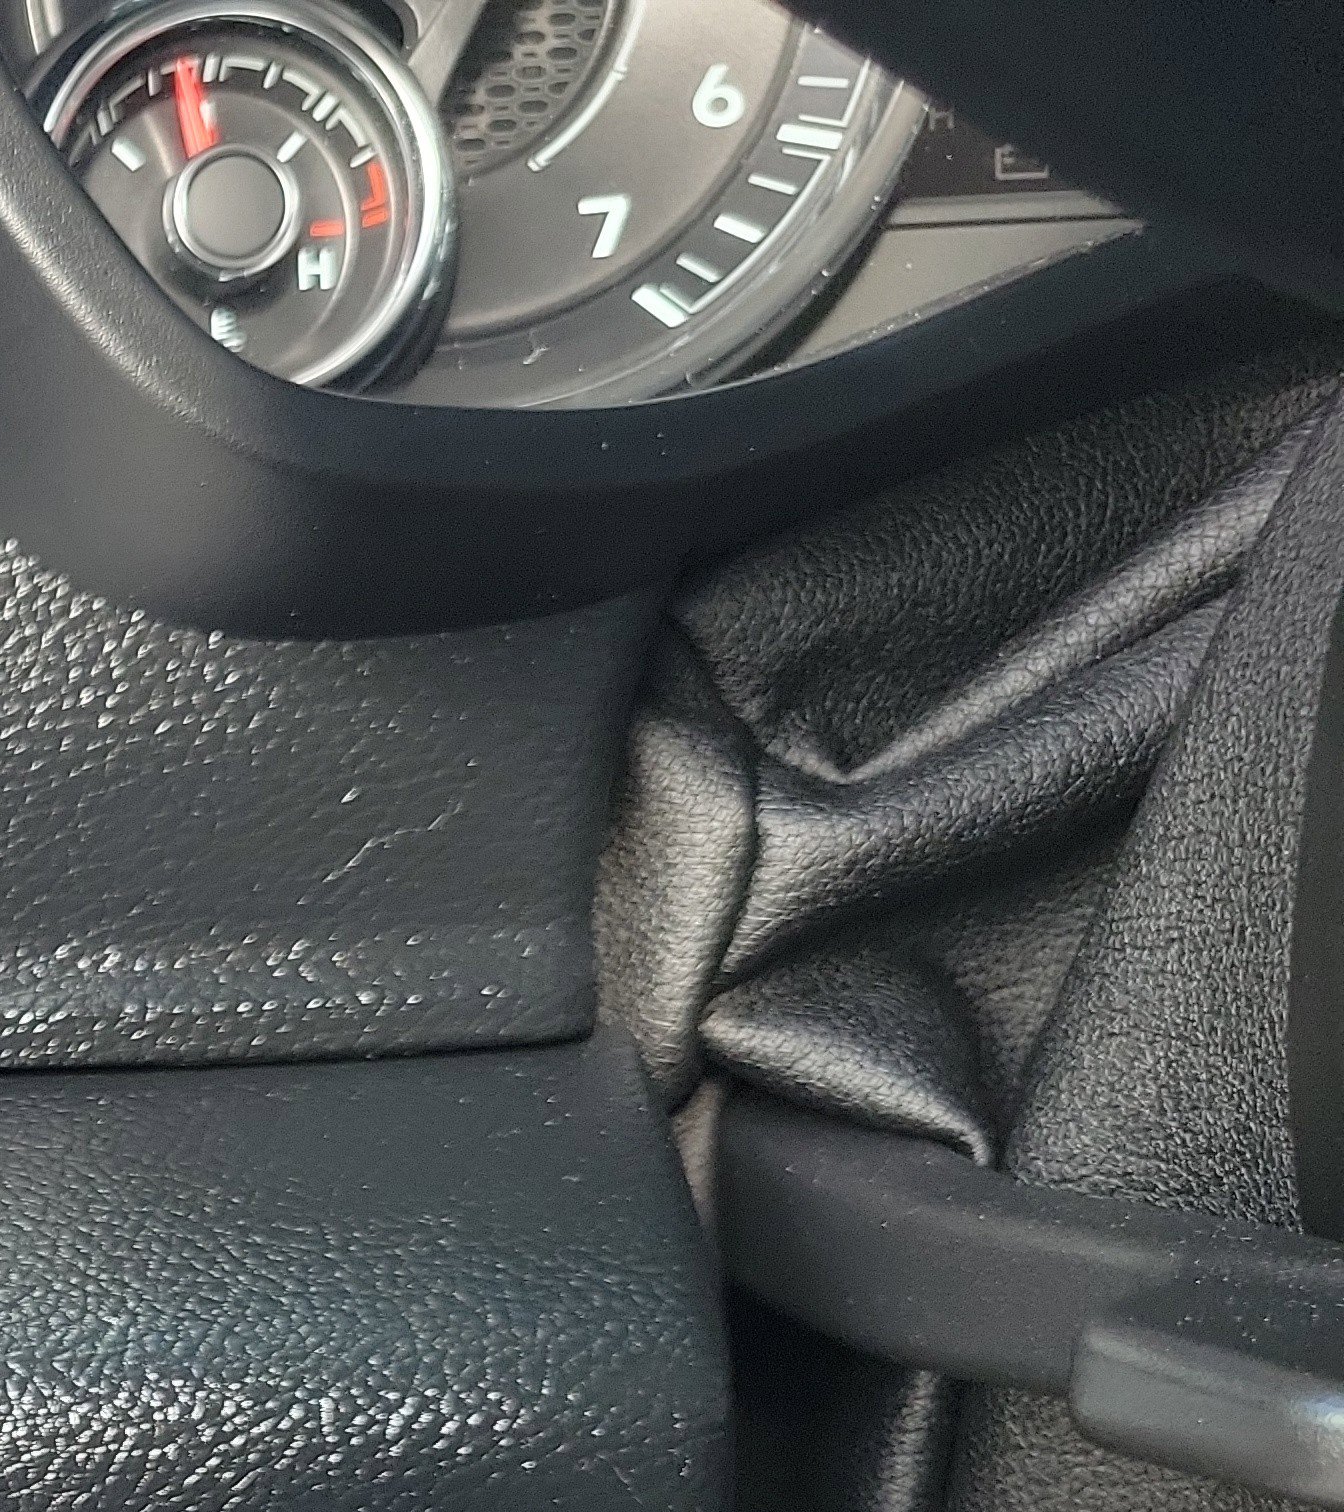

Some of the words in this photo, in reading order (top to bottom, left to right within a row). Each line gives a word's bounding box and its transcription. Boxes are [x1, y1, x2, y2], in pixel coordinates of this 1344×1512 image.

[692, 63, 744, 127] 6
[578, 194, 630, 258] 7
[297, 247, 336, 291] H
